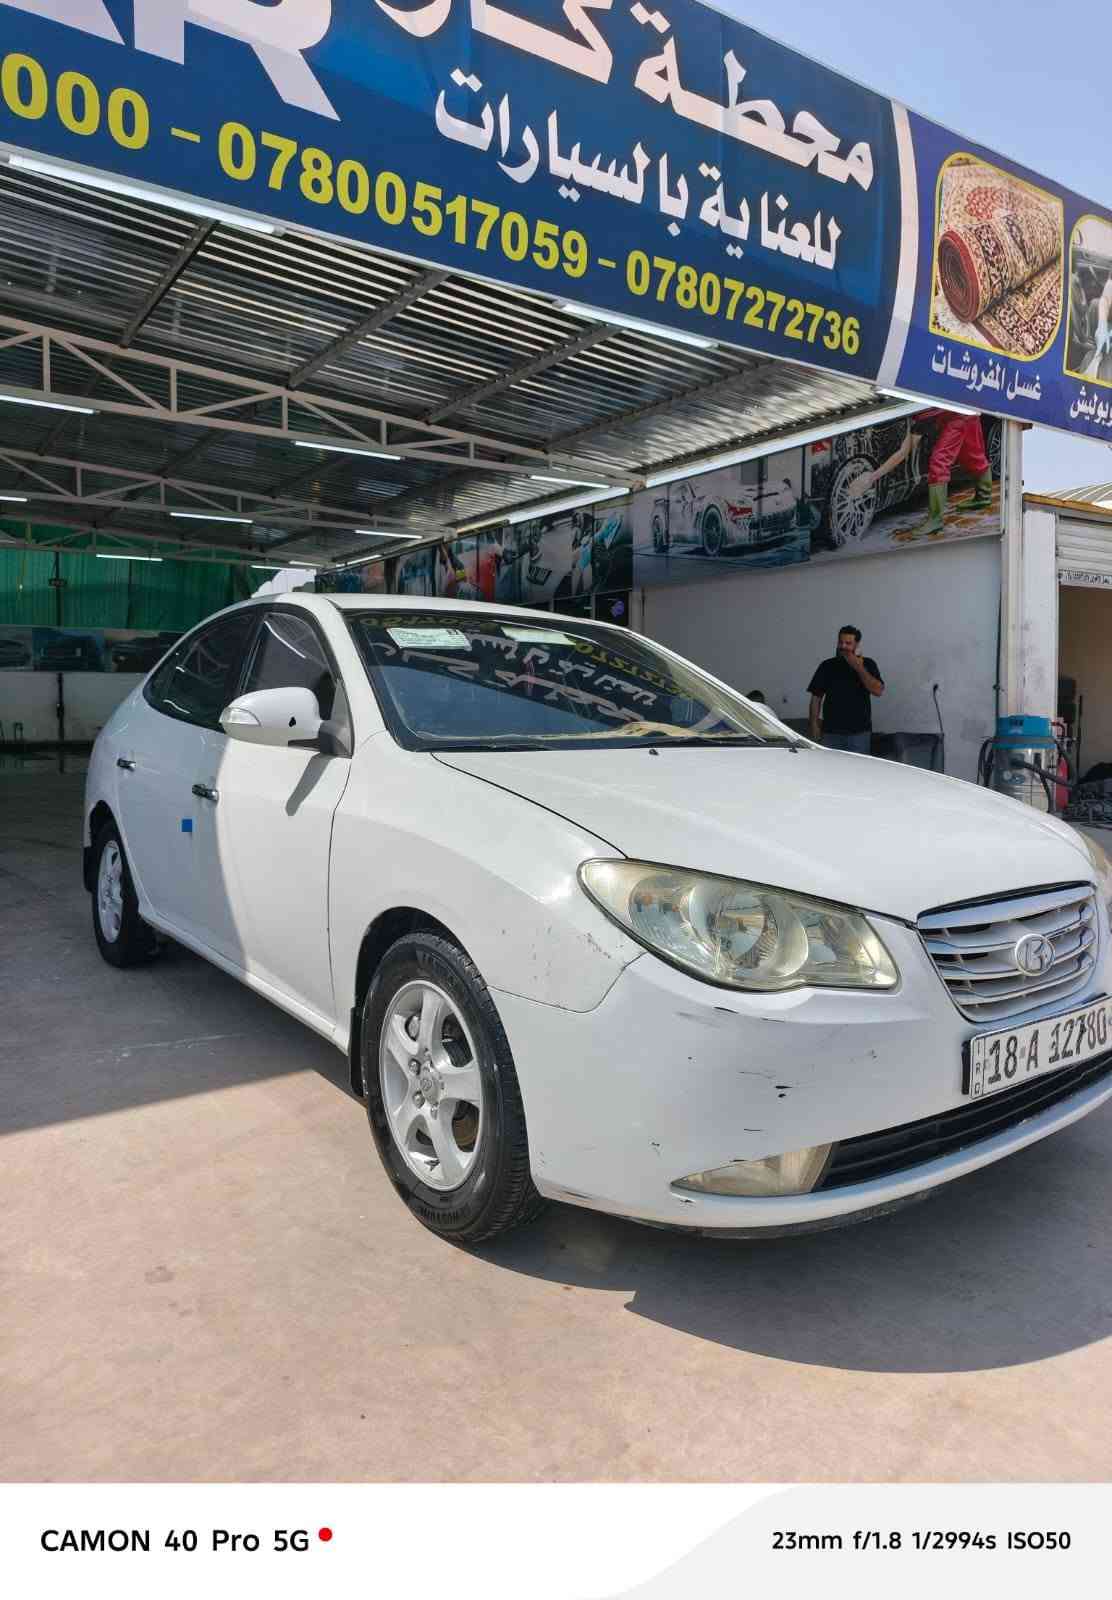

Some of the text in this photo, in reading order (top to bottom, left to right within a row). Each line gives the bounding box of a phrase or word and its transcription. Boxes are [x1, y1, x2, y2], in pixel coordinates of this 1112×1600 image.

[435, 69, 841, 270] للعناية بالسيارات
[631, 2, 874, 191] محطة
[219, 122, 588, 277] 07800517059
[626, 251, 860, 354] 07807272736
[931, 344, 1042, 401] غسل المفروشات
[987, 1007, 1107, 1085] 18 A 12780
